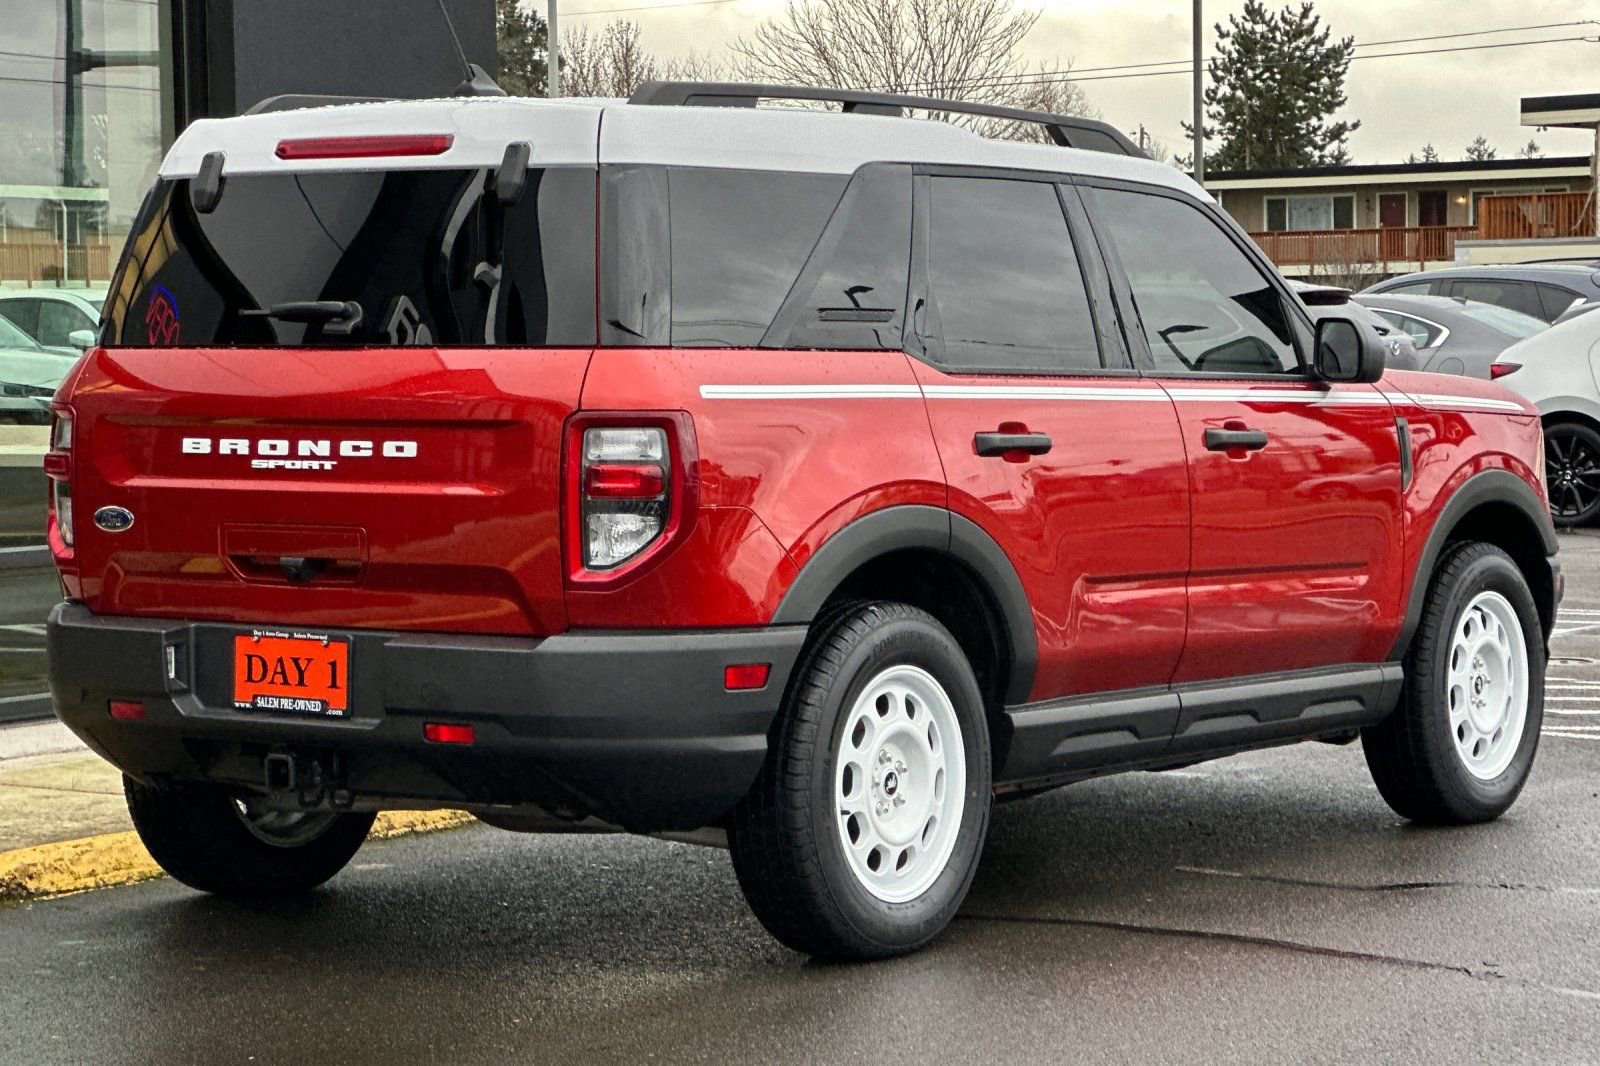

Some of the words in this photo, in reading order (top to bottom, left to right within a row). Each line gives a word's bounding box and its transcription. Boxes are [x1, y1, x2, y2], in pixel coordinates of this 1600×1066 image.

[182, 438, 418, 458] BRONCO
[251, 460, 337, 470] SPORT
[244, 653, 315, 688] DAY
[327, 660, 341, 689] 1
[257, 697, 279, 709] SALEM
[280, 698, 321, 712] PRE-OWNED
